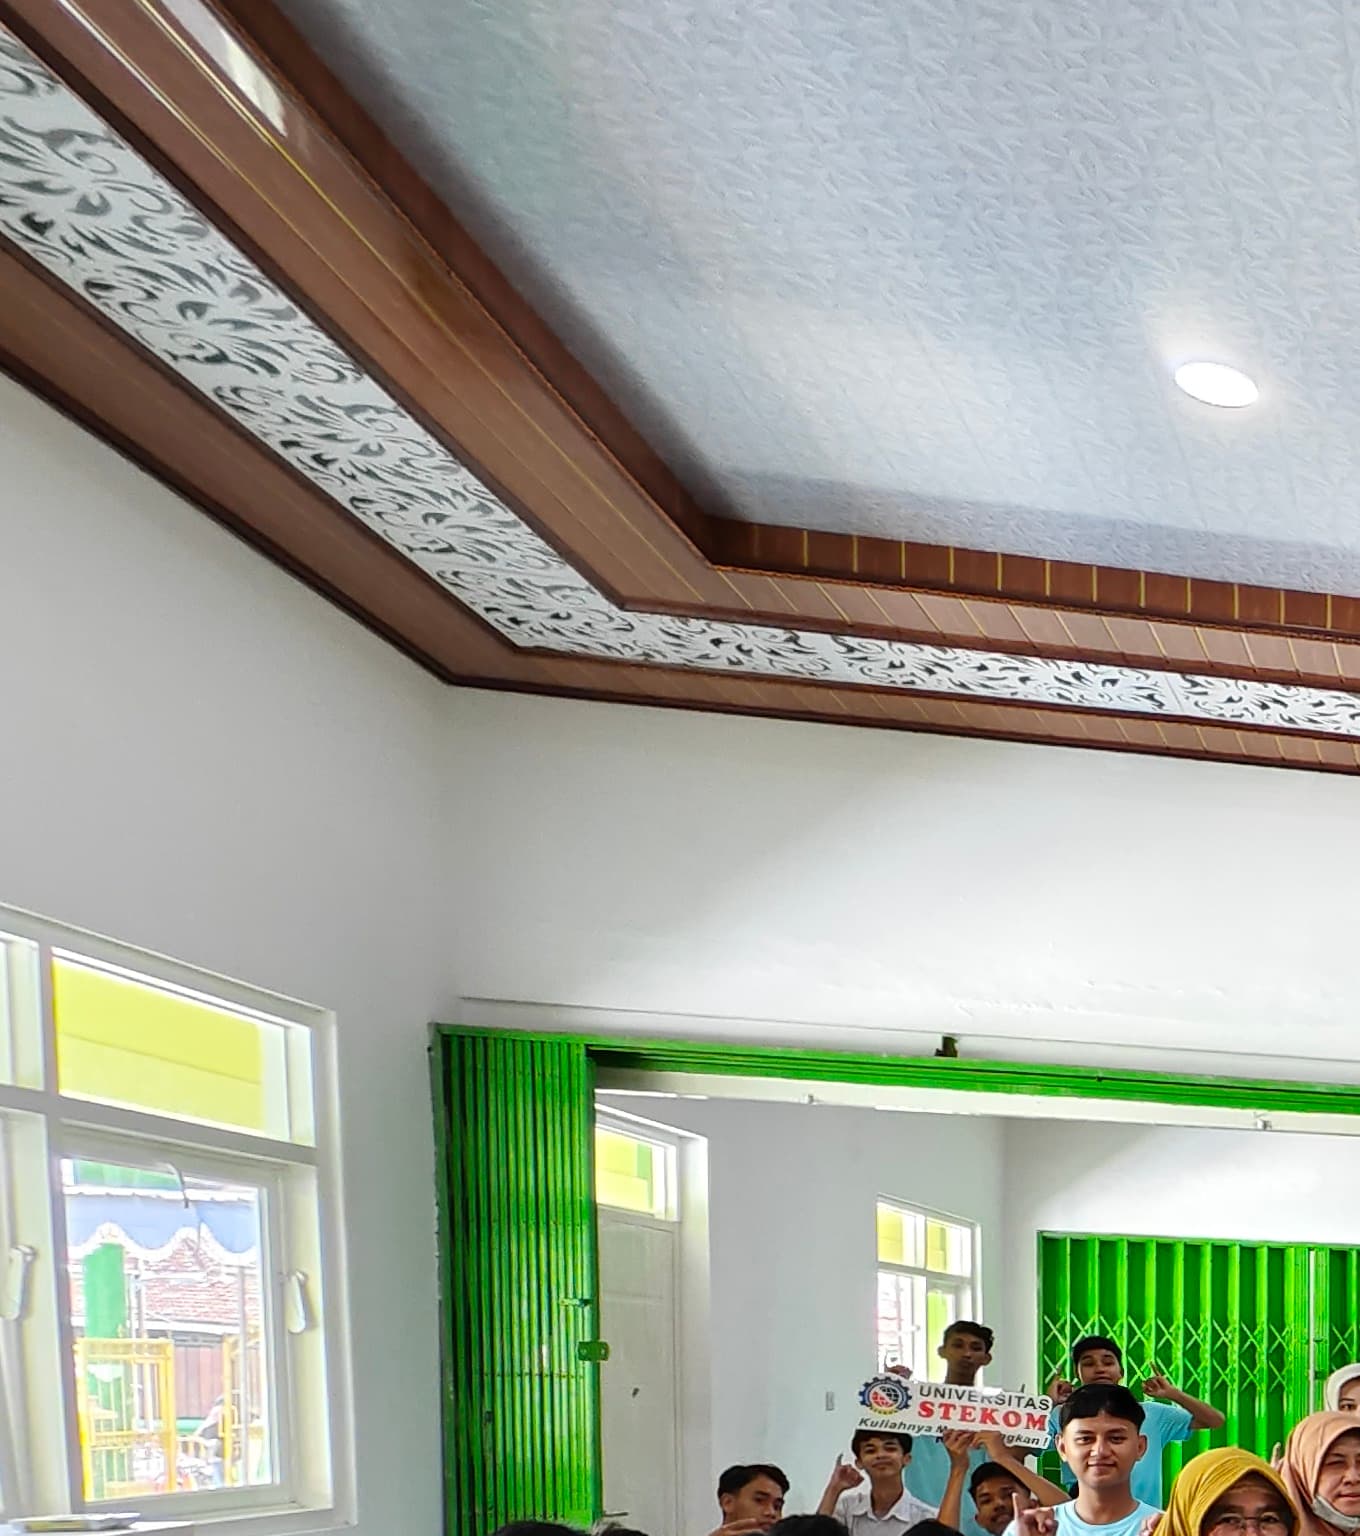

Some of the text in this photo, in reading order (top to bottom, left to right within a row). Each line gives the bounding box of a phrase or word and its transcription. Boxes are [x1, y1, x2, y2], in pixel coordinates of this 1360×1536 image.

[918, 1384, 1050, 1411] UNIVERSITAS
[858, 1417, 933, 1434] Kuliahnya
[917, 1400, 1048, 1431] STEKOM
